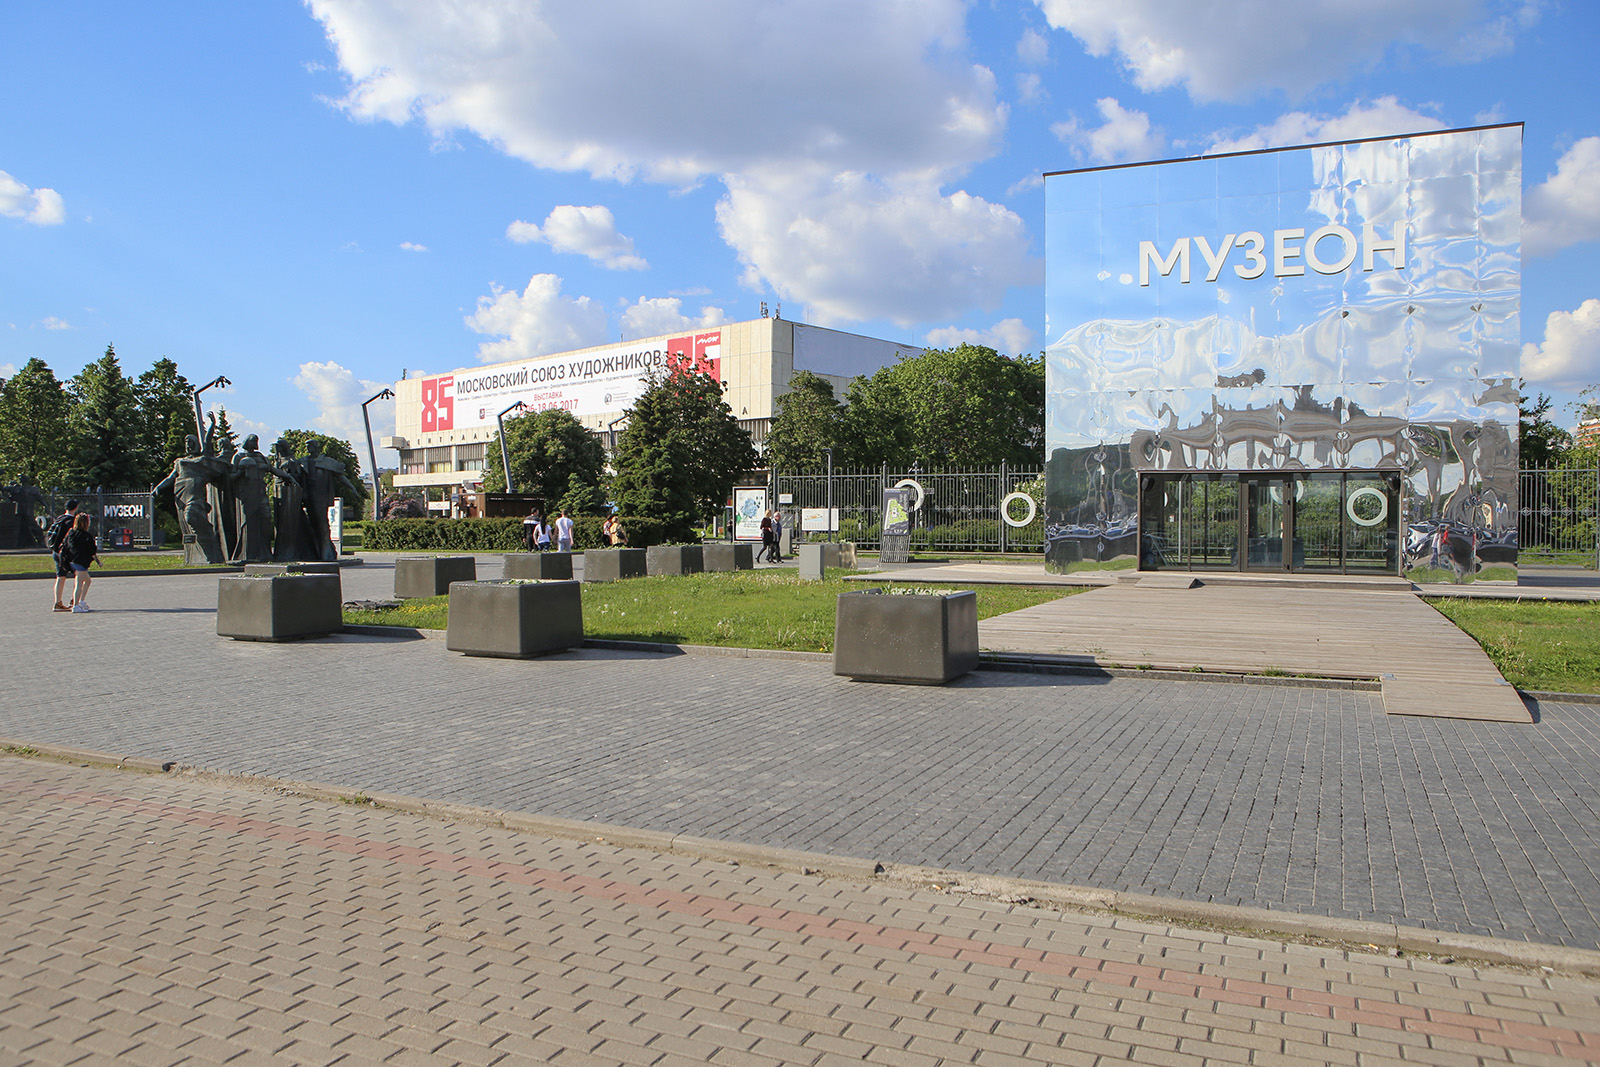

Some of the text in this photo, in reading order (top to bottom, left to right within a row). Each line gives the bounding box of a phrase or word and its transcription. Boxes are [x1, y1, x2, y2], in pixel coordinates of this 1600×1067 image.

[1139, 220, 1406, 286] МУЗЕОН
[457, 366, 528, 395] МОСКОВСКИЙ
[531, 364, 565, 383] СОЮЗ
[569, 350, 661, 379] ХУДОЖНИКОВ
[422, 376, 454, 433] 85
[534, 391, 563, 401] ВЫСТАВКА
[104, 504, 143, 517] МУЗЕОН
